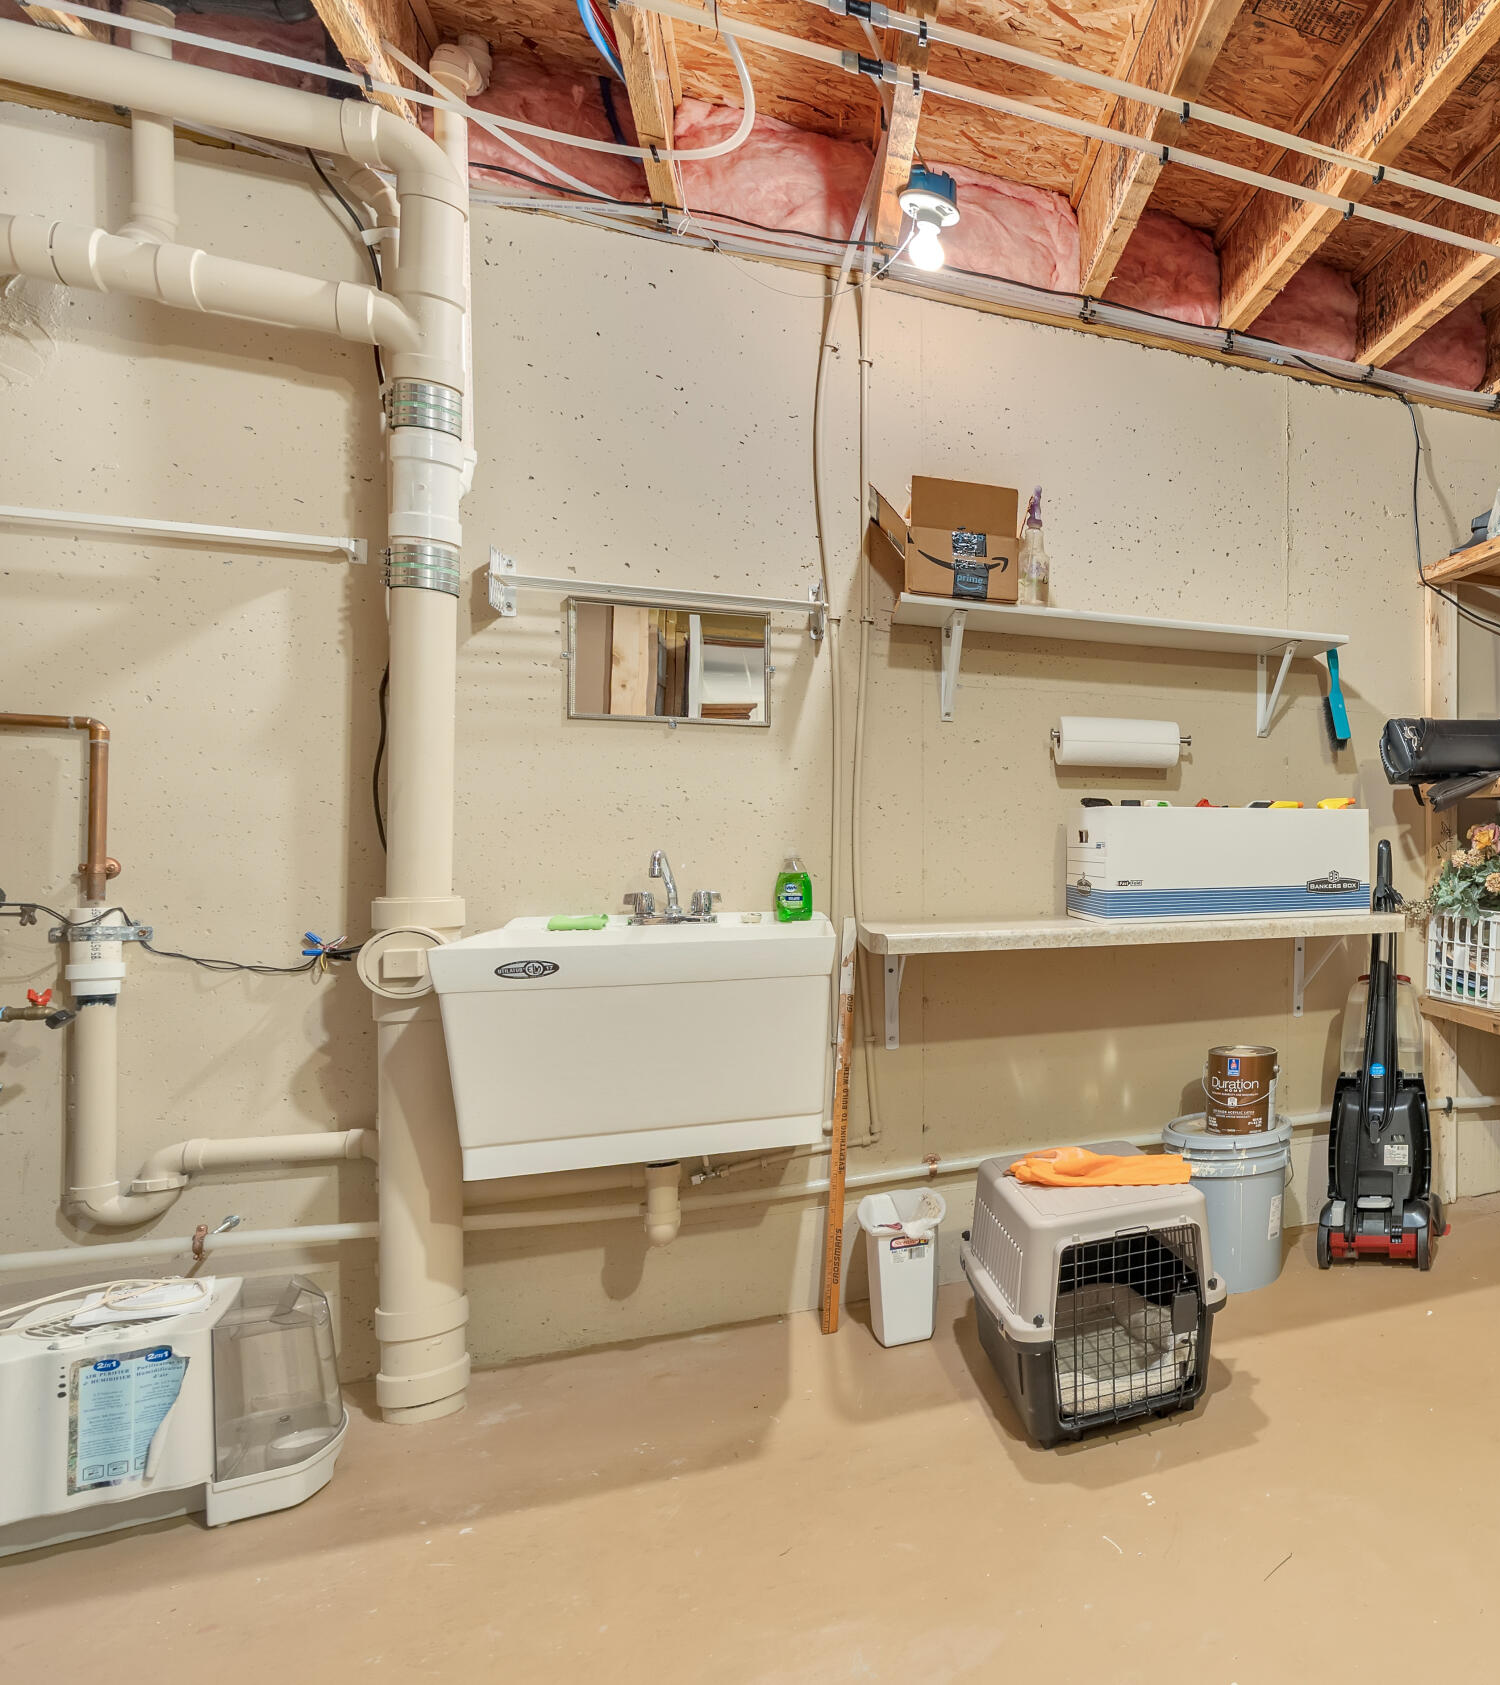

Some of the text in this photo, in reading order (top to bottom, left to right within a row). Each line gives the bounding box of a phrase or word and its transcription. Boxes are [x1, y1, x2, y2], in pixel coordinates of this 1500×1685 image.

[1359, 16, 1430, 122] TJI 110
[956, 574, 984, 584] prime
[1212, 1076, 1259, 1090] Duration
[841, 1112, 848, 1123] TO
